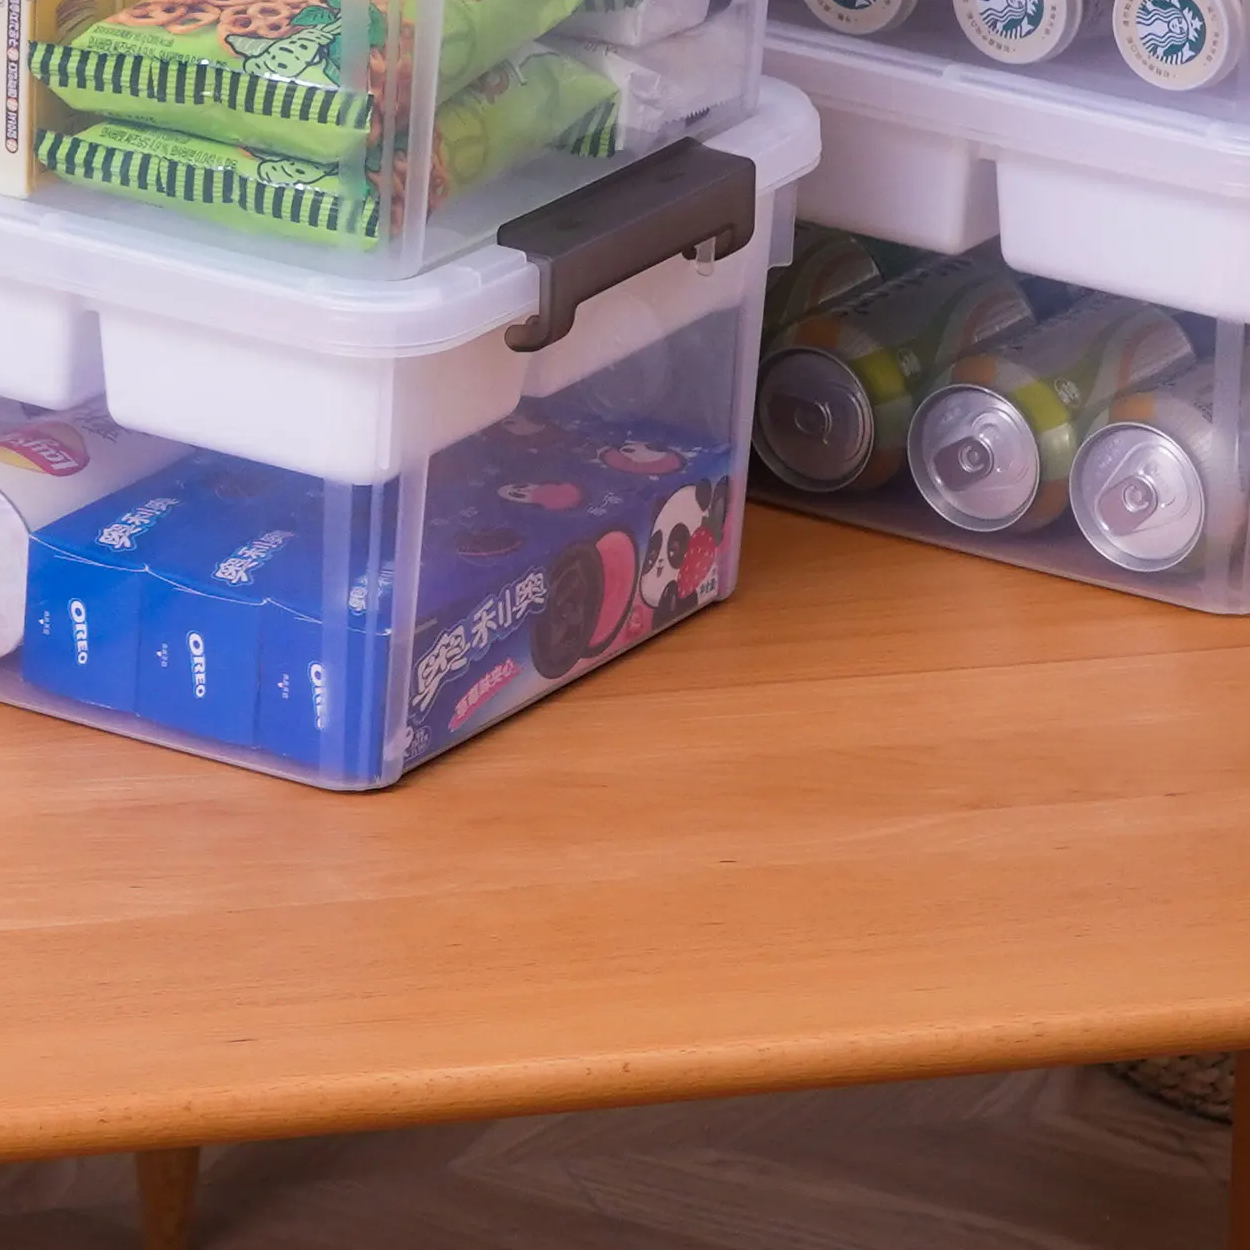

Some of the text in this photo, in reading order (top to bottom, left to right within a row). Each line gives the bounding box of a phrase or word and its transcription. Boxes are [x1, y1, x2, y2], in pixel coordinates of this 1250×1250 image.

[99, 498, 180, 549] 奥利奥
[215, 530, 296, 584] 奥利奥
[70, 599, 89, 665] OREO
[411, 571, 548, 713] 奥利奥
[188, 632, 207, 699] OREO
